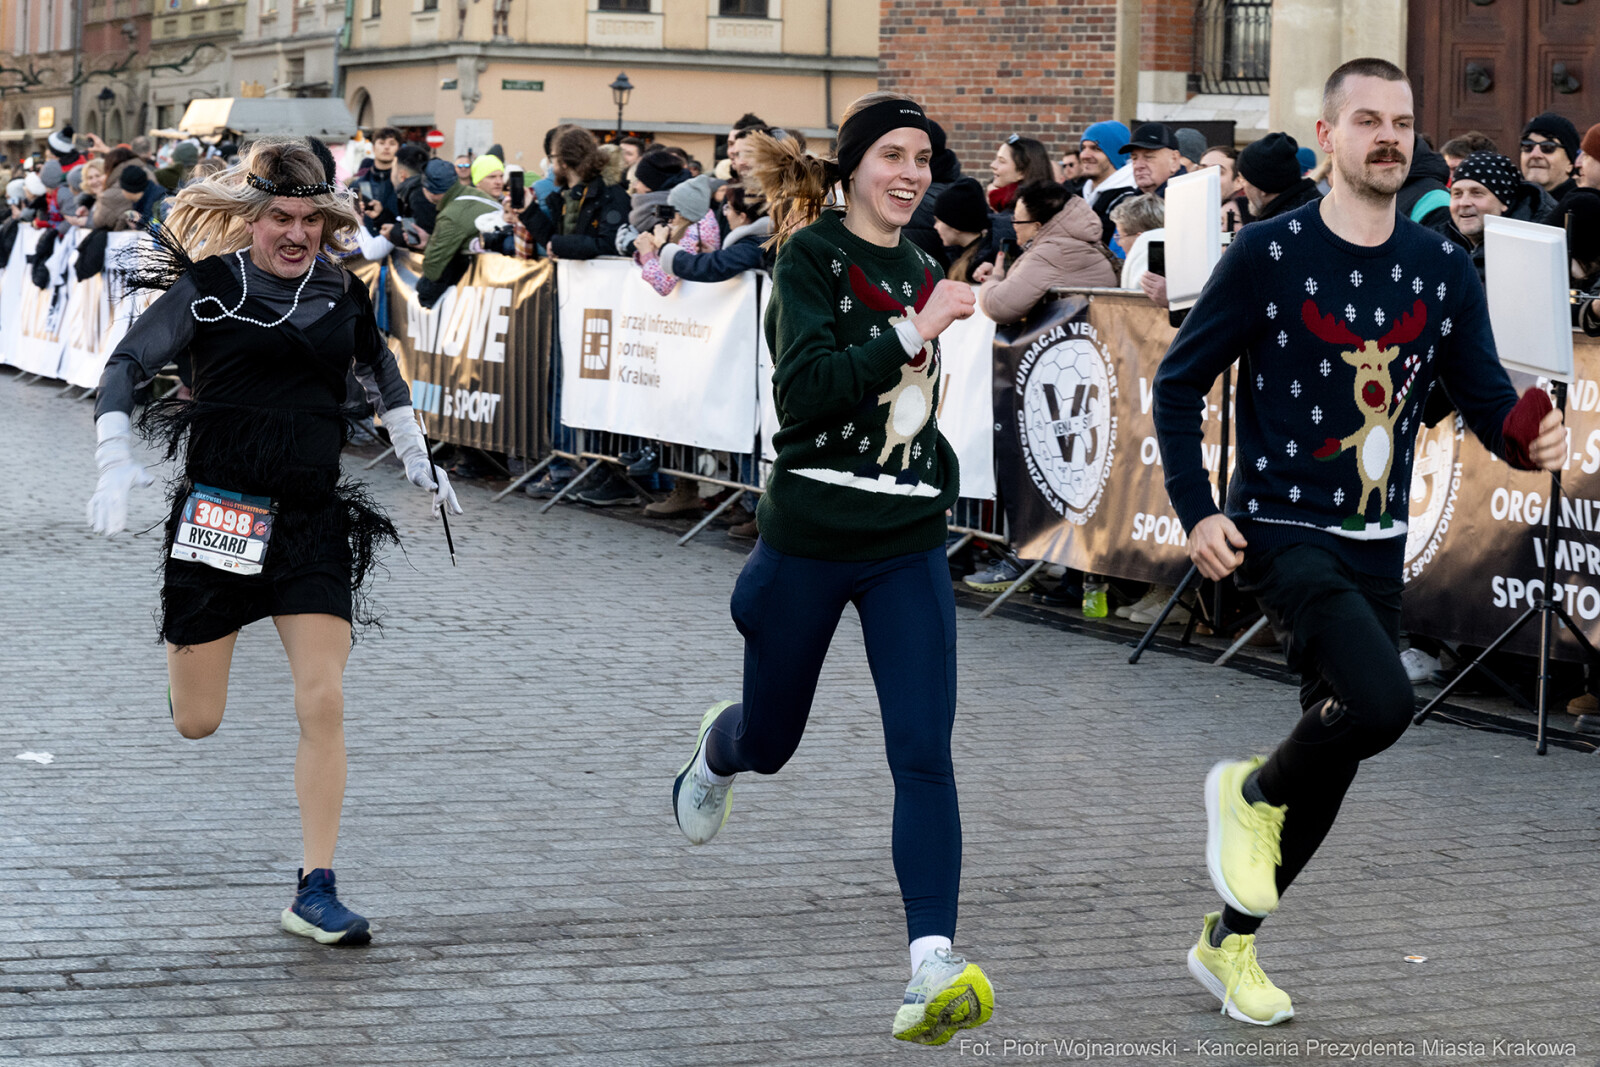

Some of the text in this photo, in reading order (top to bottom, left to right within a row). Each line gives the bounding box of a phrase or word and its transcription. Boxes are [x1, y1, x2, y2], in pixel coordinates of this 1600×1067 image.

[1016, 325, 1067, 396] FUNDACJA
[443, 386, 501, 424] is SPORT
[1017, 409, 1064, 516] ORGANIZACJA
[195, 502, 251, 535] 3098
[234, 502, 270, 515] SYLWESTROW
[1411, 462, 1463, 578] SPORTOWYCH
[188, 526, 248, 555] RYSZARD
